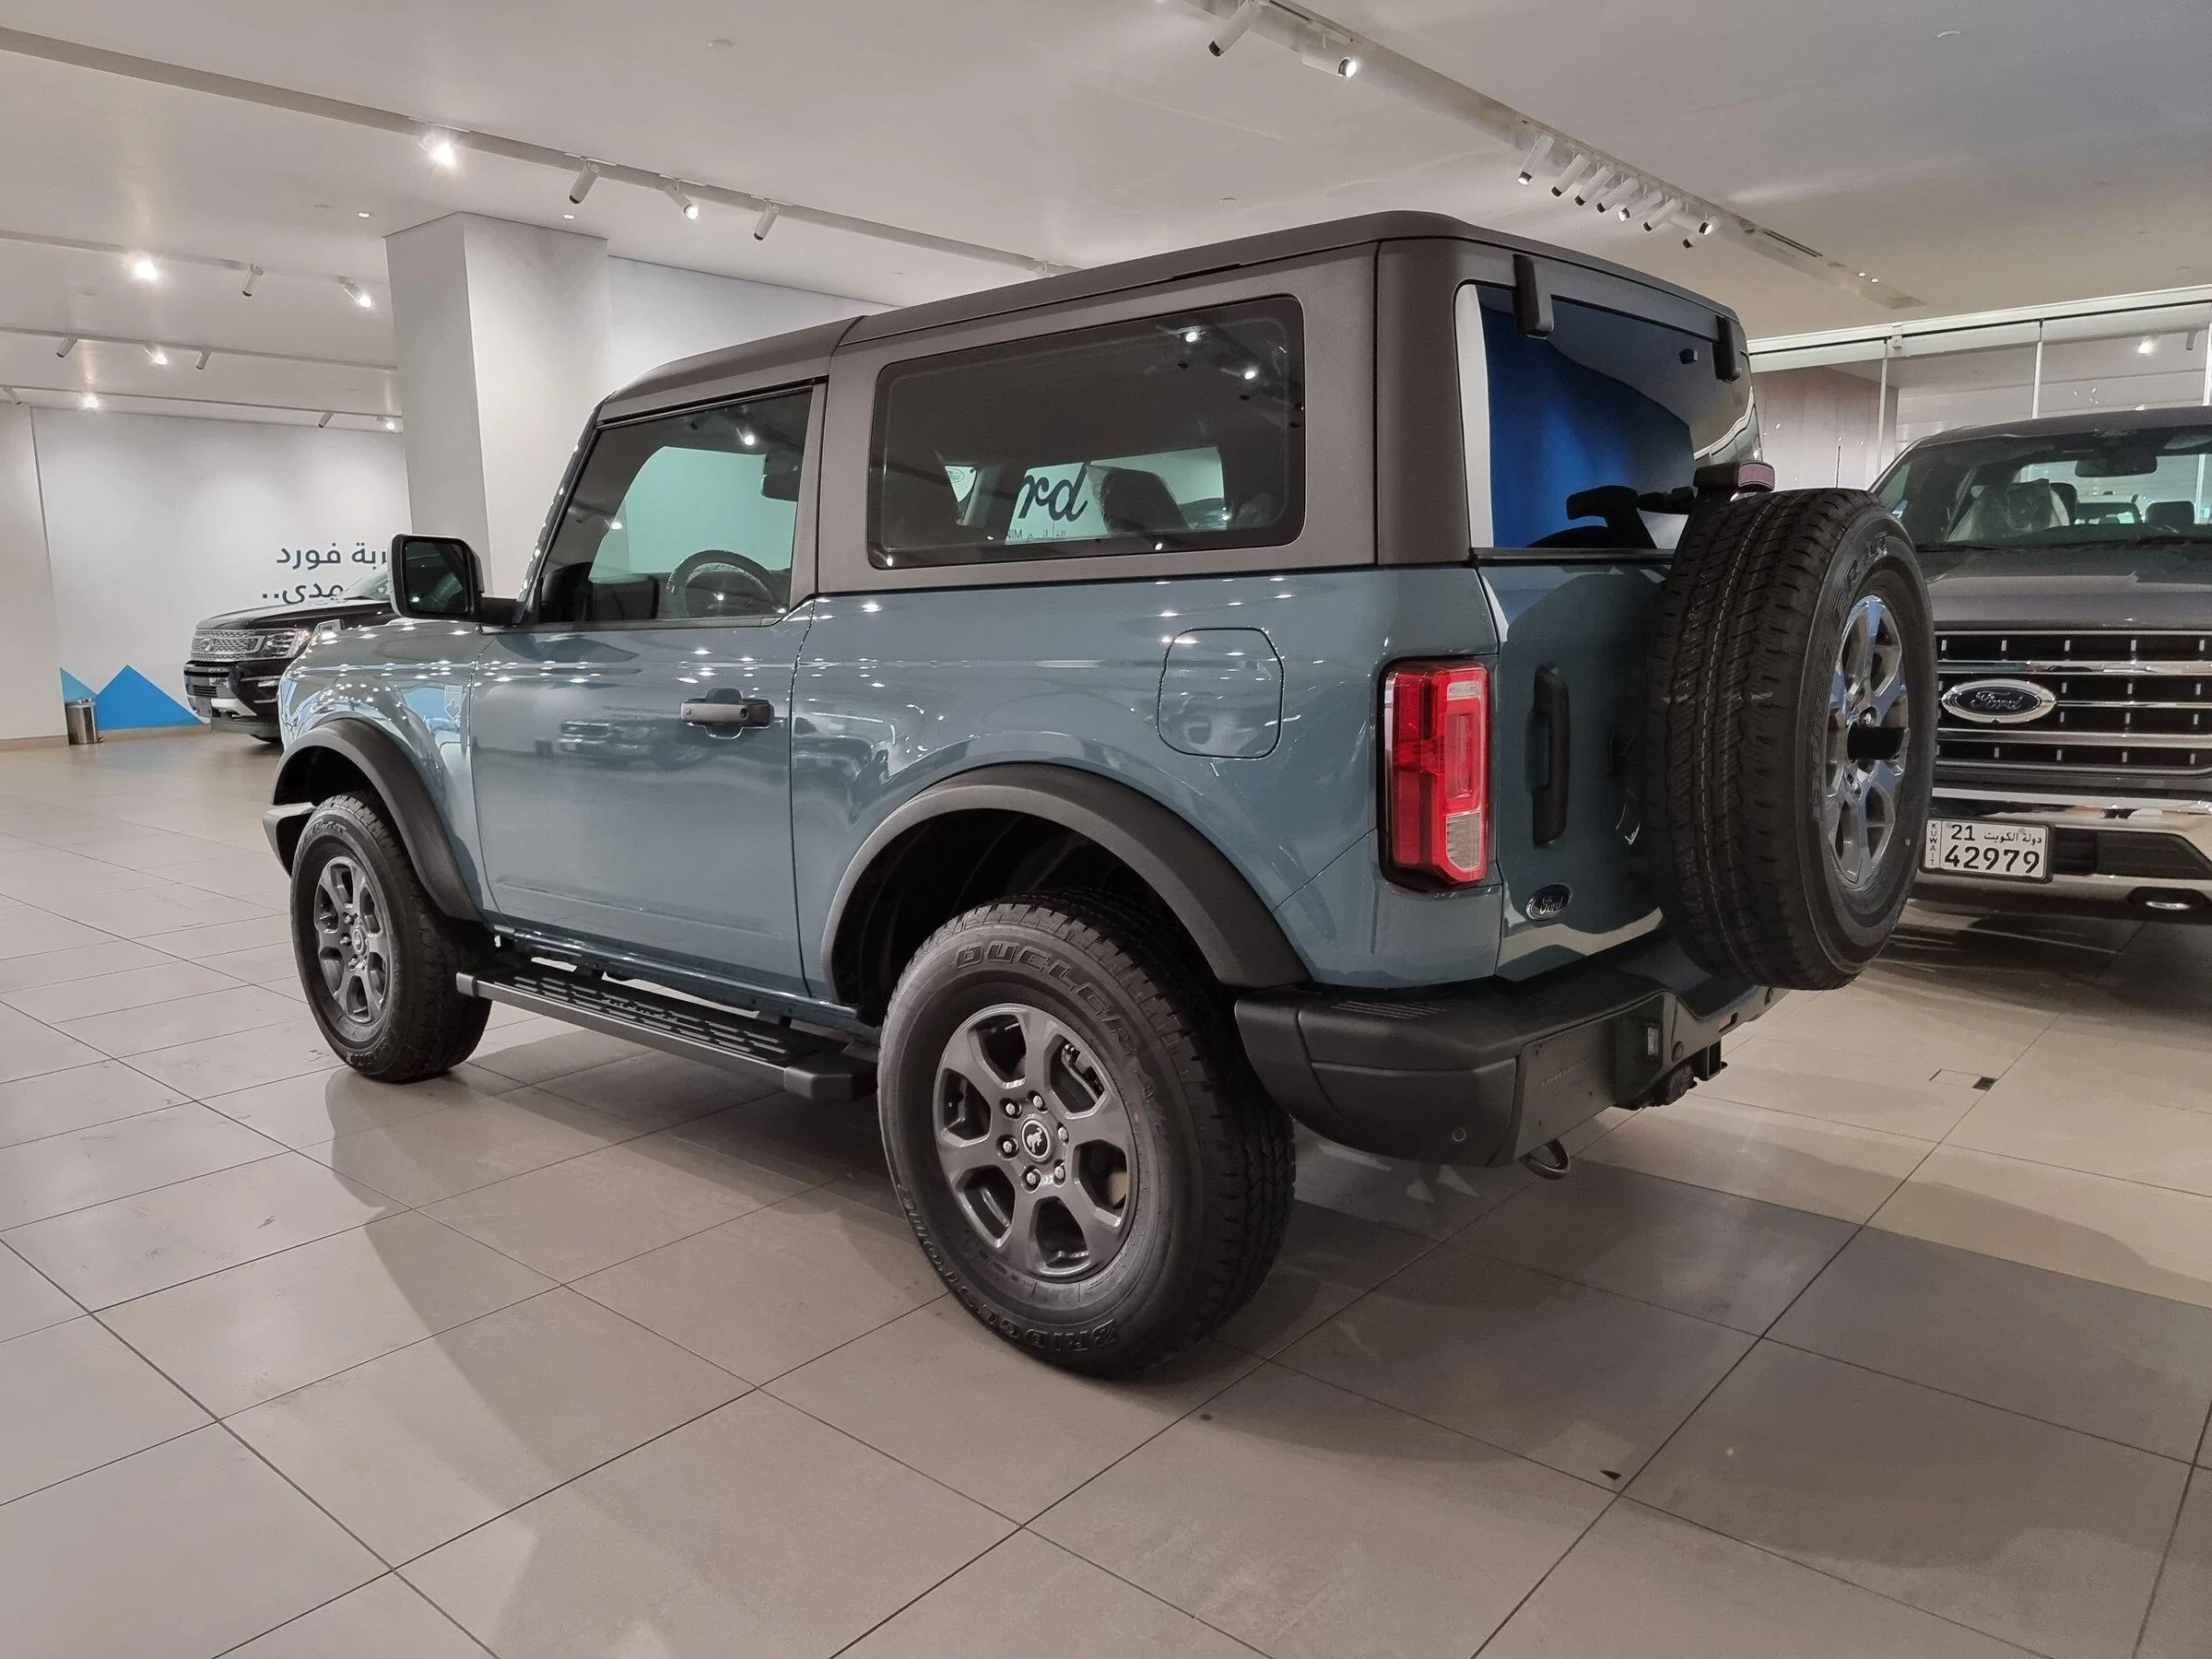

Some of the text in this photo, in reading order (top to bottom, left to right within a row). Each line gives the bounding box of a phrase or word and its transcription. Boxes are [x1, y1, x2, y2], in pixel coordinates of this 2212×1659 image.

[1017, 463, 1088, 523] rd
[276, 542, 388, 571] ربة فورد
[1970, 691, 2024, 712] Ford
[1929, 822, 1938, 866] KUWAIT
[1951, 824, 1976, 841] 21
[1983, 831, 2042, 846] دولة الكويت
[1944, 844, 2041, 874] 42979
